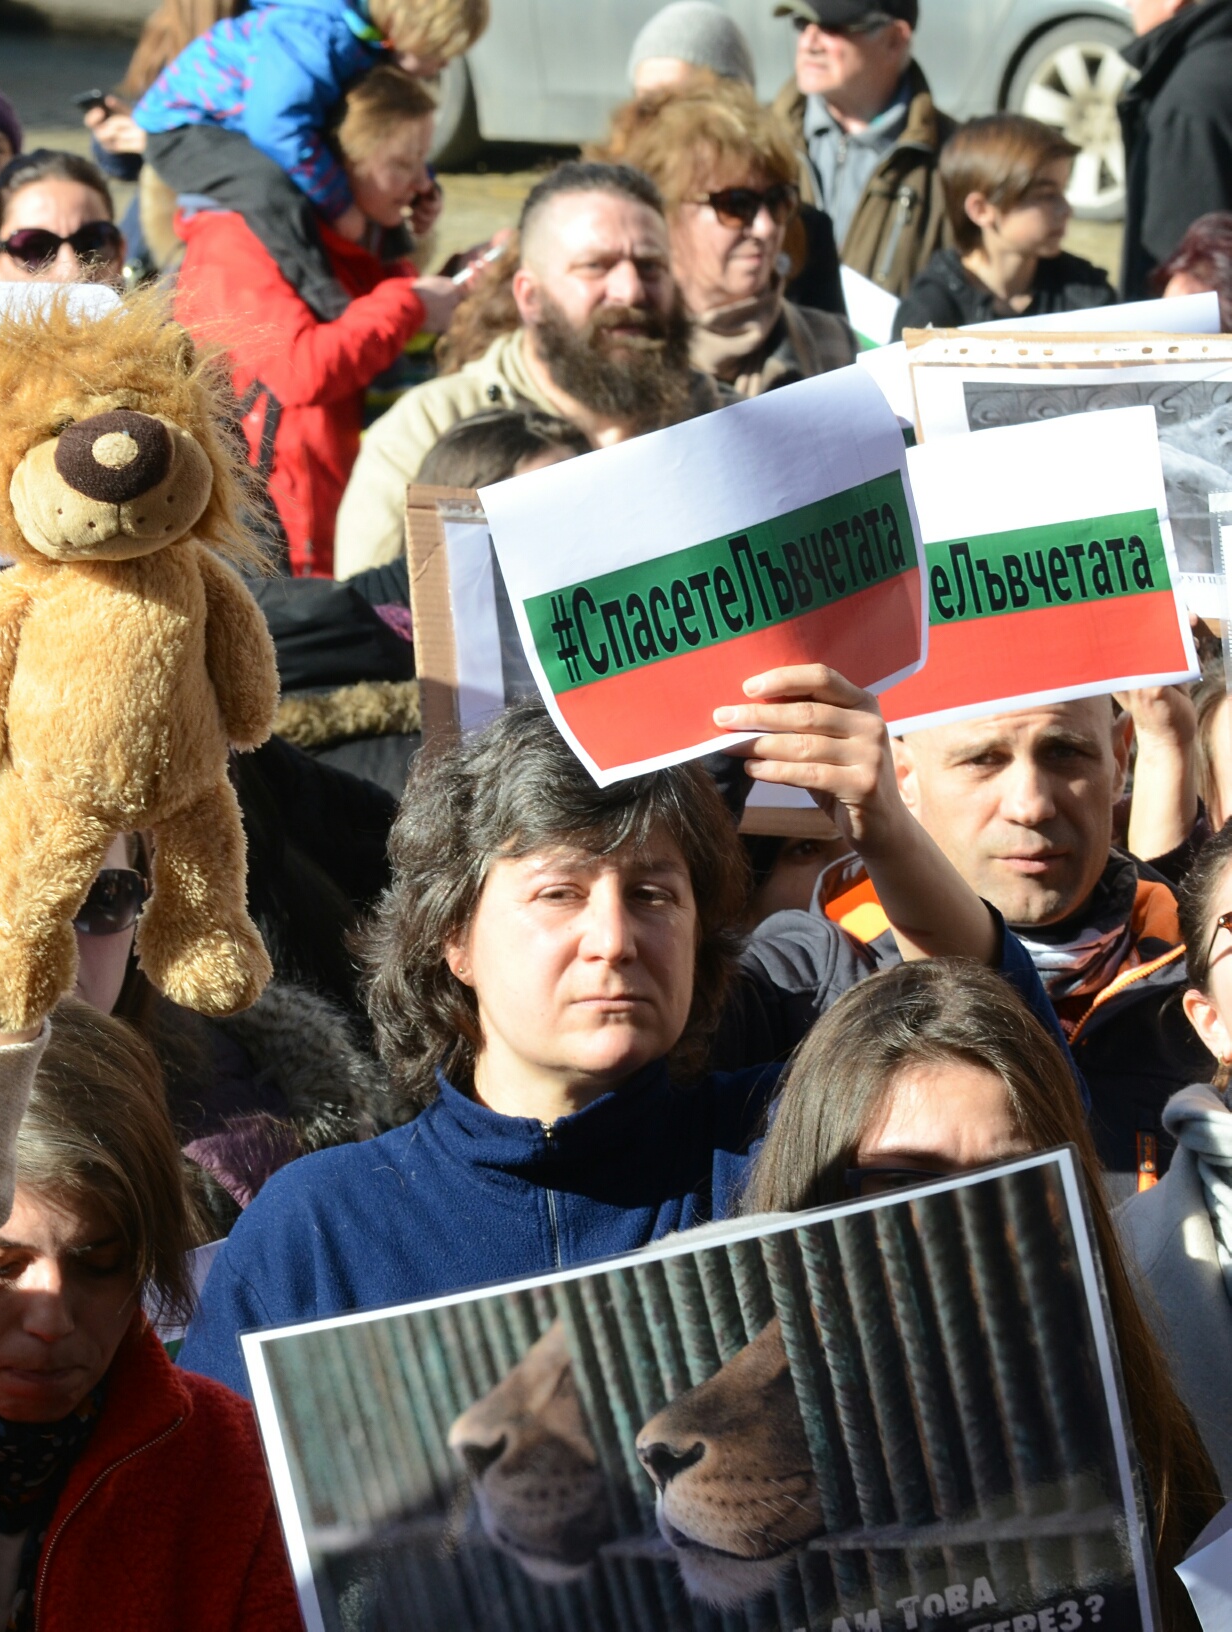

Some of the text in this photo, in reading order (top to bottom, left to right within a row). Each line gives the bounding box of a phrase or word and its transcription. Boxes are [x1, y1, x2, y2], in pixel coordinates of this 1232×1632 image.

[550, 502, 907, 683] #СпасетеЛъвчетата
[928, 535, 1155, 621] еЛъвчетата
[896, 1576, 997, 1630] ТОВА
